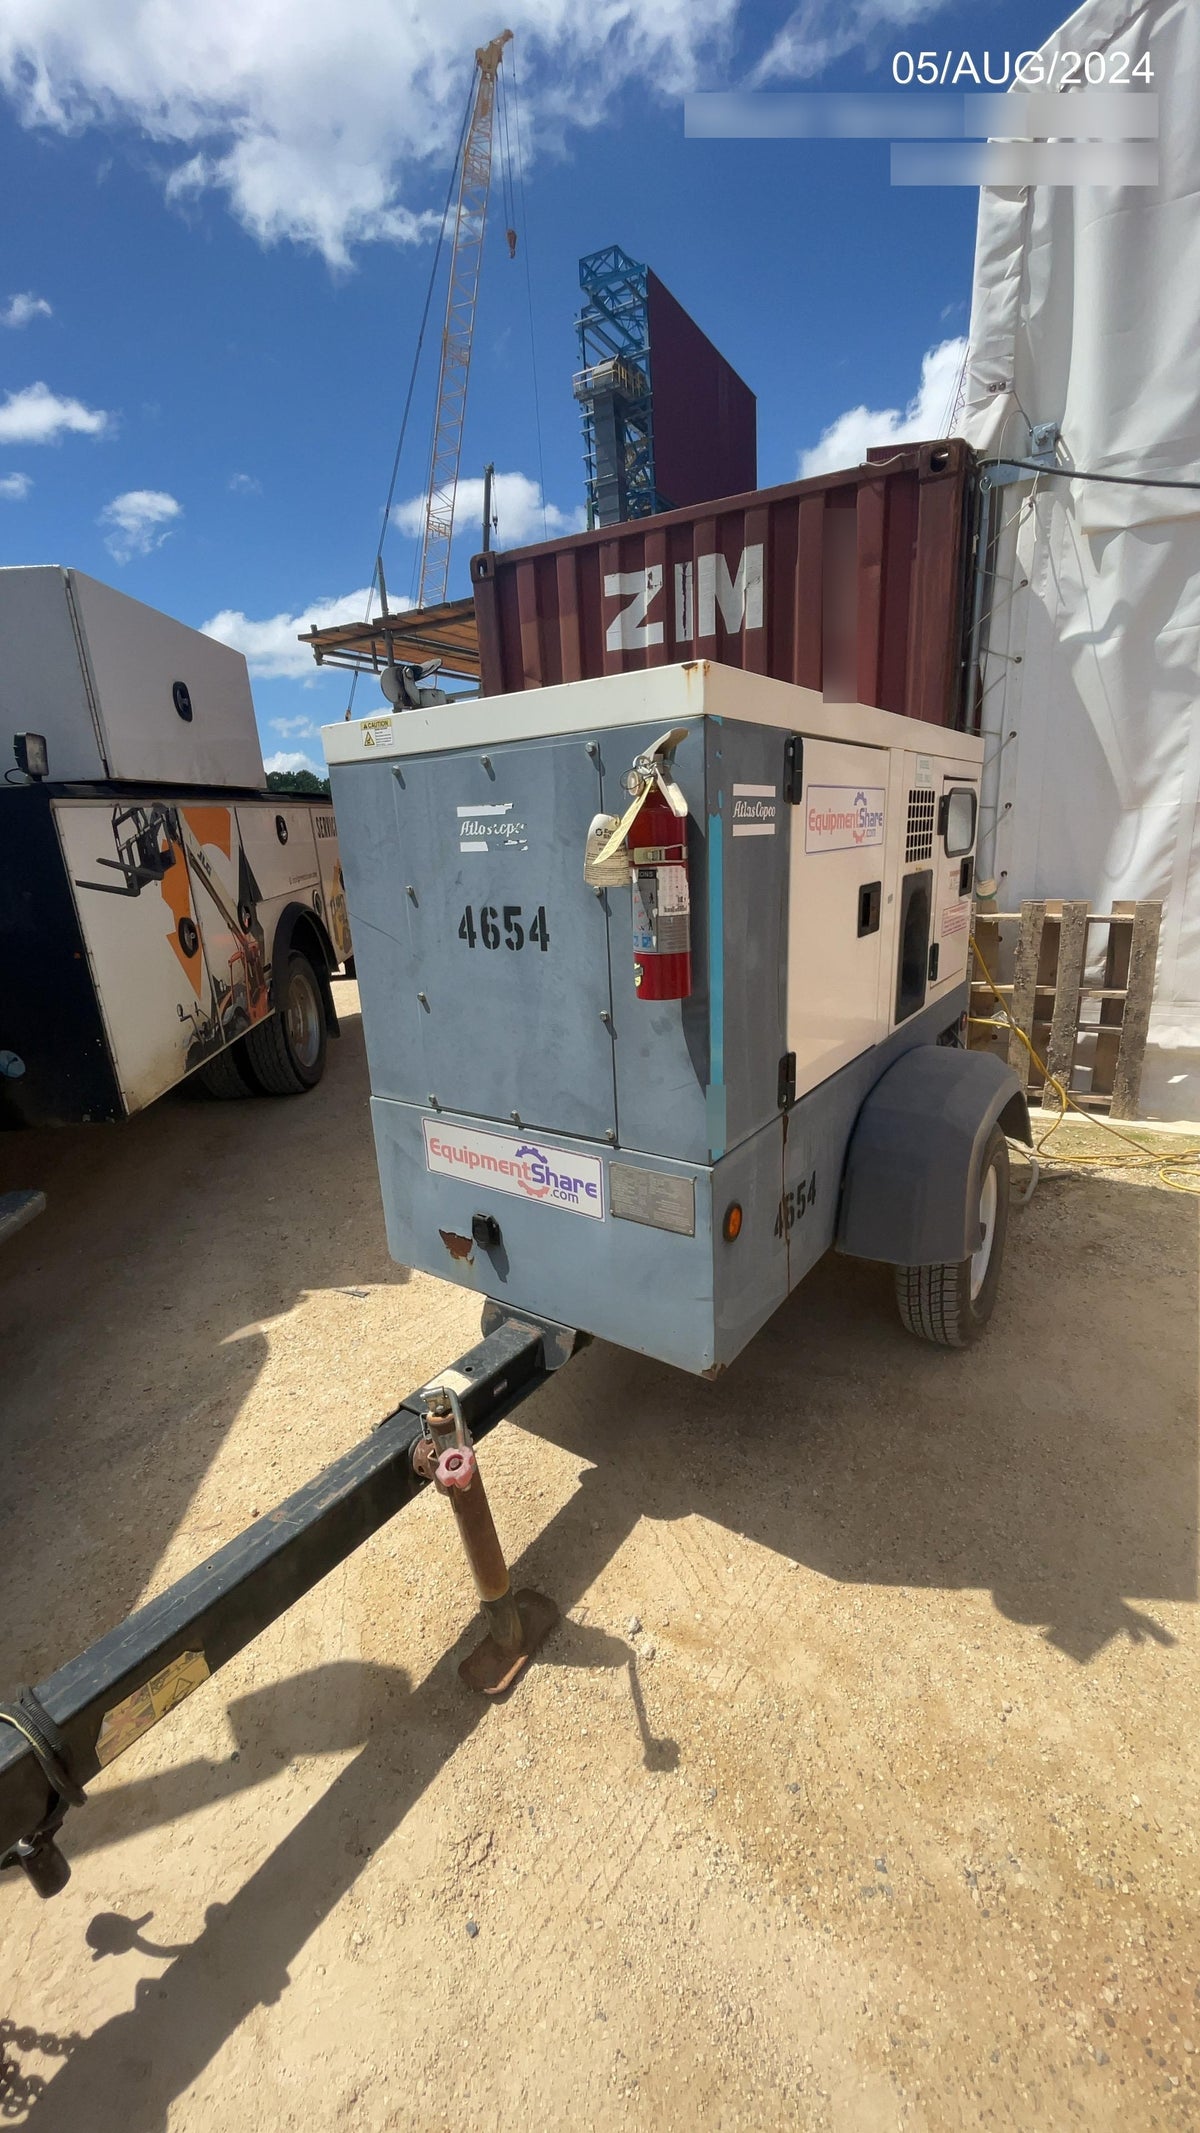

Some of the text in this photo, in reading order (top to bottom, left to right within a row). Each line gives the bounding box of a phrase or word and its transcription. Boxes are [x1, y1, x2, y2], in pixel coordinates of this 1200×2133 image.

[604, 543, 764, 652] ZIM
[367, 720, 389, 729] CAUTION
[808, 807, 883, 836] EquipmentShare
[458, 905, 550, 952] 4654
[429, 1137, 598, 1199] EquipmentShare
[550, 1189, 579, 1205] .com
[774, 1170, 816, 1239] 4654
